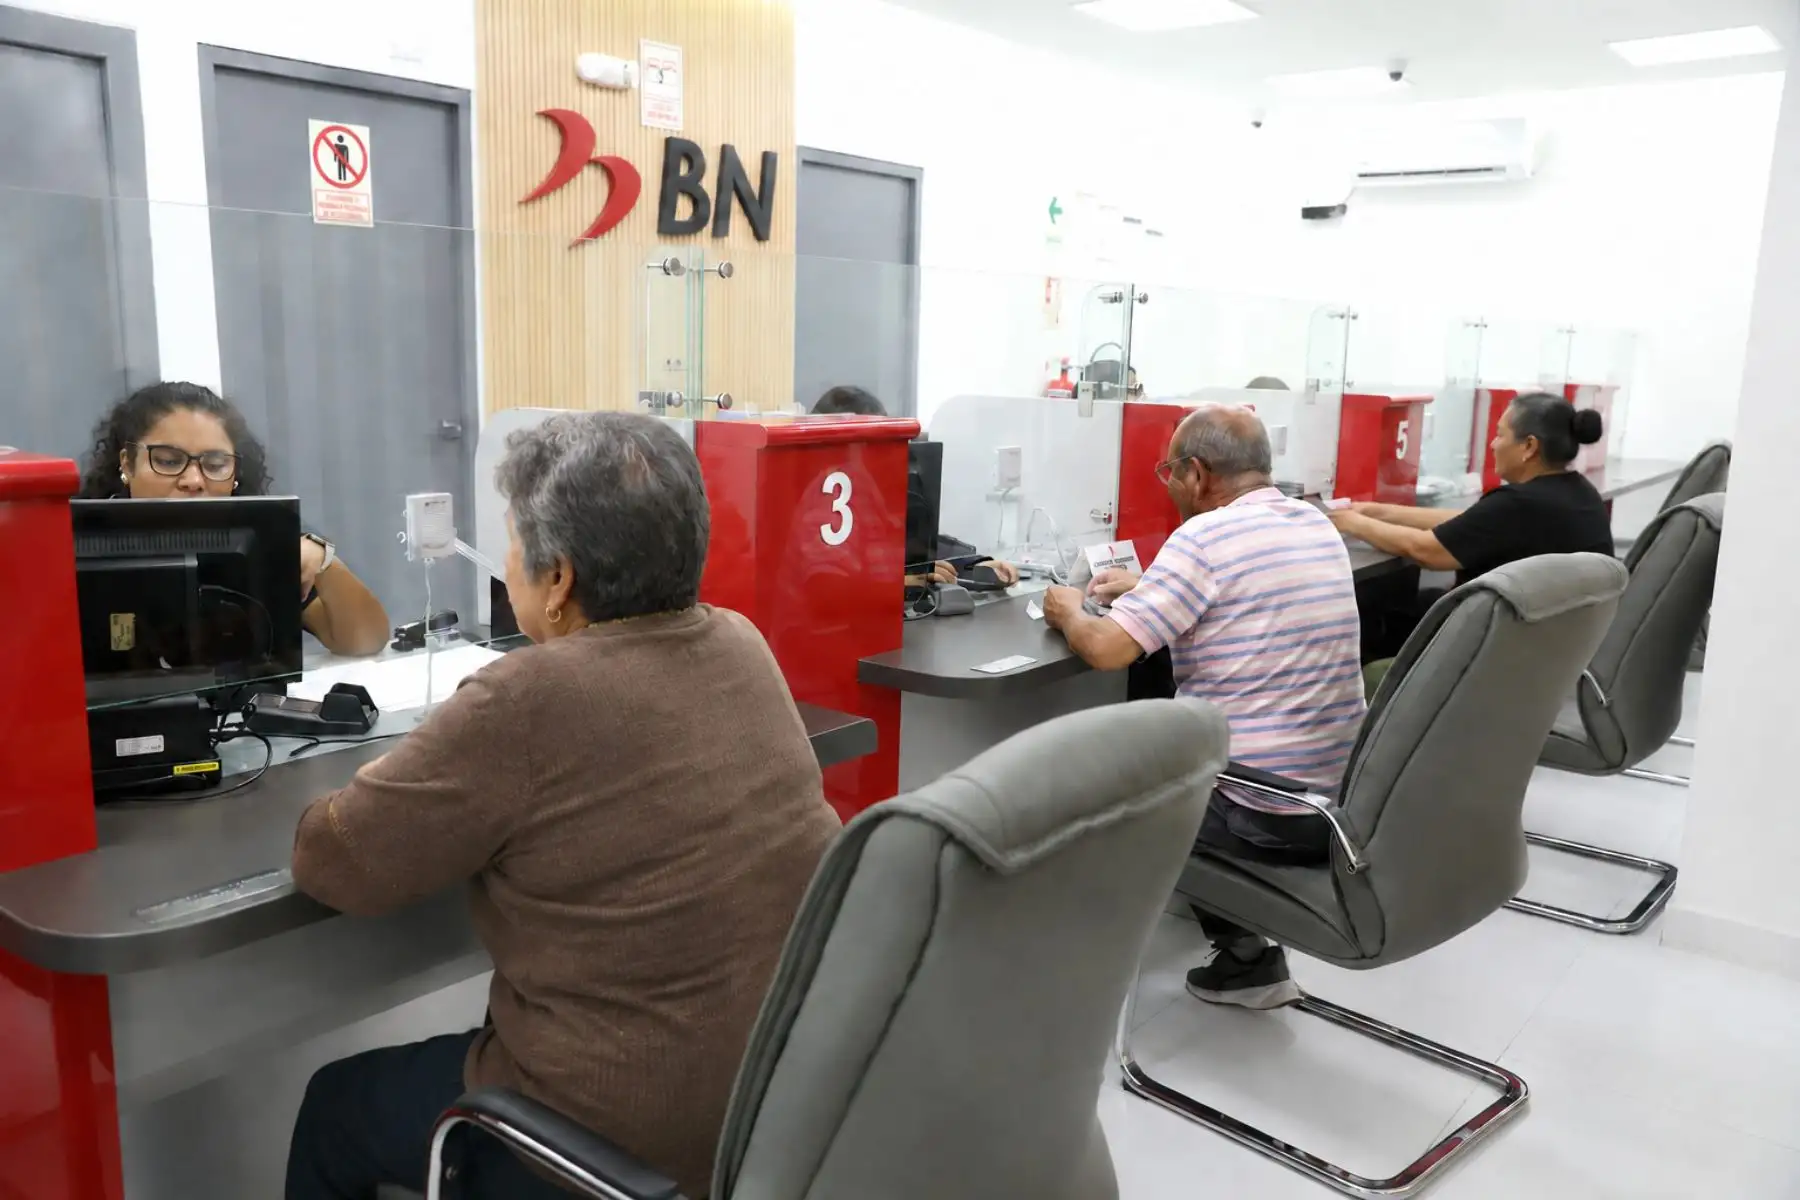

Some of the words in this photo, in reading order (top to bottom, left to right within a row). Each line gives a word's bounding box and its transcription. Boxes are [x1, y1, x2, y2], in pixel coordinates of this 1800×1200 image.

[657, 136, 778, 242] BN
[1395, 420, 1408, 460] 5
[820, 471, 853, 546] 3
